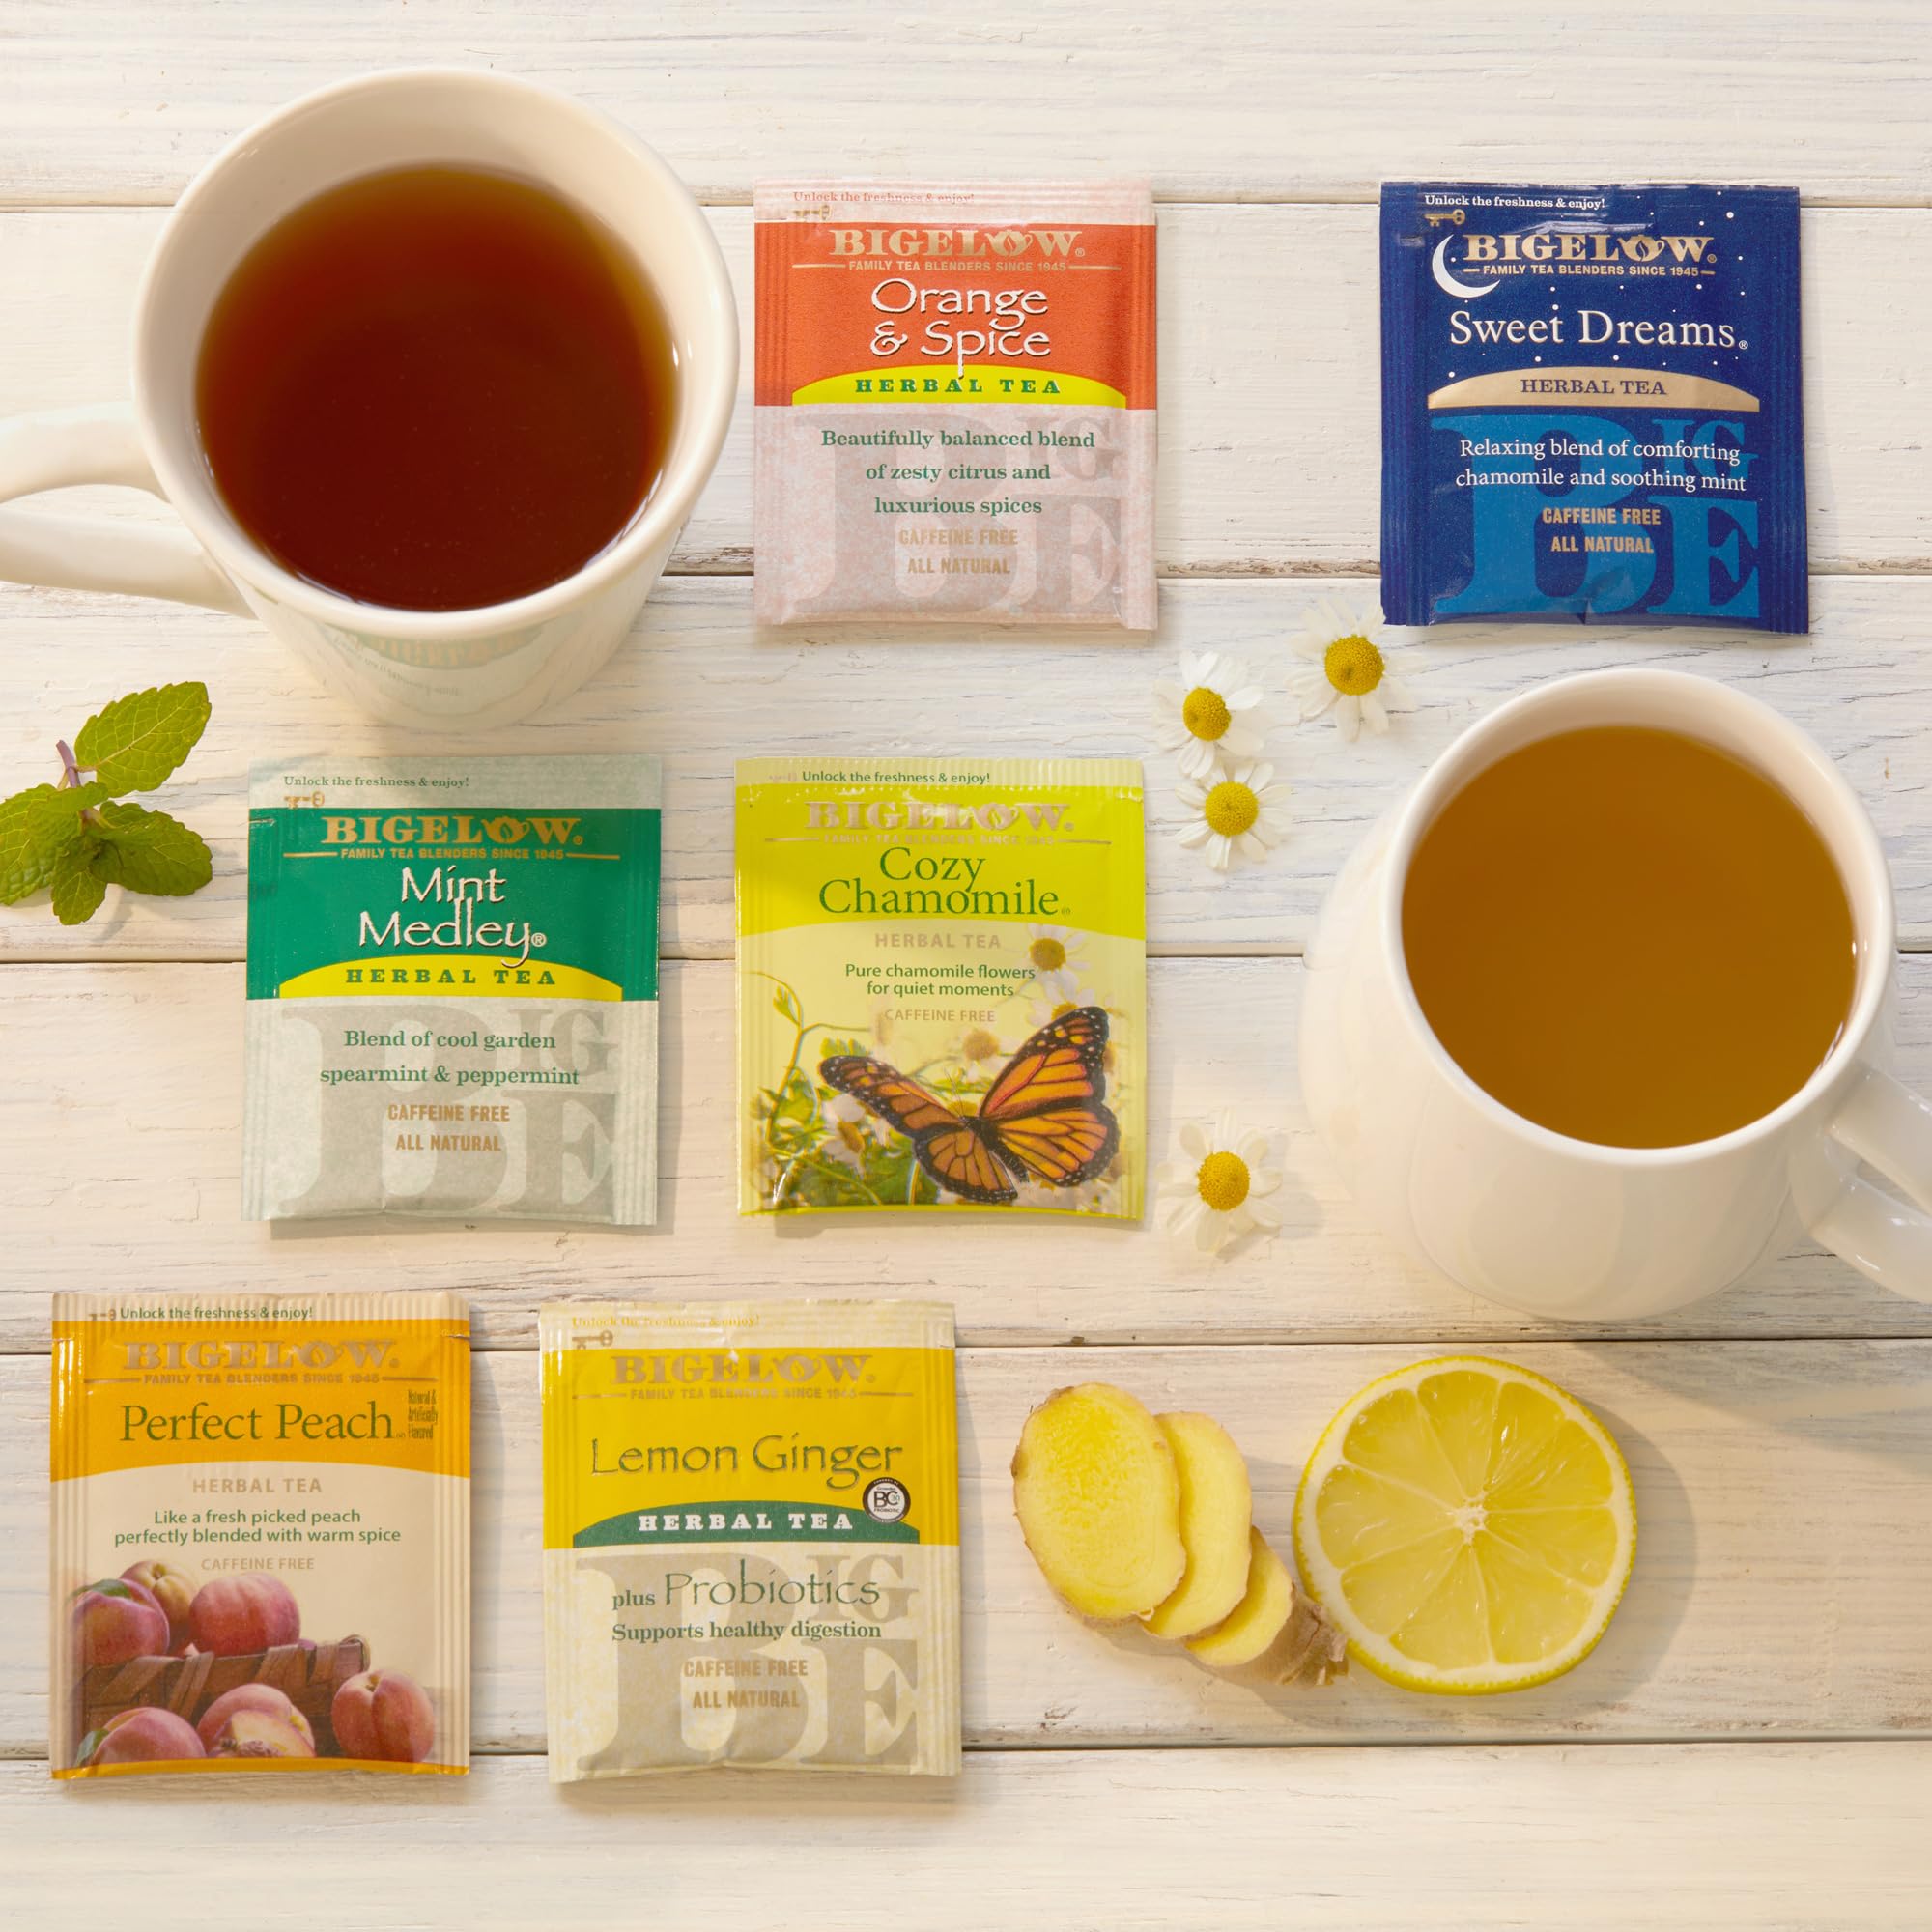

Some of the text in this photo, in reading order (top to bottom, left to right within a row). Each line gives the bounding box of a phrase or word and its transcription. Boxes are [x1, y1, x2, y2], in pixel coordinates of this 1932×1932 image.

[793, 192, 838, 202] Unlock
[840, 192, 859, 202] the
[1425, 195, 1605, 210] Unlock the freshness & enjoy!
[849, 260, 1066, 271] FAMILY TEA BLENDERS SINCE 1945
[1483, 265, 1699, 276] FAMILY TEA BLENDERS SINCE 1945
[871, 277, 1049, 331] Orange
[1450, 310, 1564, 345] Sweet
[870, 320, 1051, 380] & Spice
[856, 379, 1061, 394] HERBAL TEA
[1520, 378, 1667, 395] HERBAL TEA
[821, 429, 1094, 449] Beautifully balanced blend
[1460, 439, 1740, 464] Relaxing blend of comforting
[866, 464, 1051, 483] of zesty citrus and
[1455, 469, 1747, 493] chamomile and soothing mint
[874, 497, 1042, 518] luxurious spices
[1542, 507, 1661, 525] CAFFEINE FREE
[899, 529, 1018, 545] CAFFEINE FREE
[1550, 536, 1654, 554] ALL NATURAL
[907, 557, 1010, 574] ALL NATURAL
[284, 776, 469, 789] Unlock the freshness & enjoy!
[802, 771, 990, 785] Unlock the freshness & enjoy!
[876, 835, 900, 845] TEA
[980, 836, 1019, 845] SINCE
[341, 848, 564, 860] FAMILY TEA BLENDERS SINCE 1945
[879, 846, 986, 894] Cozy
[400, 865, 506, 904] Mint
[875, 932, 1001, 949] HERBAL TEA
[346, 968, 555, 985] HERBAL TEA
[845, 963, 1035, 980] Pure chamomile flowers
[867, 981, 1014, 998] for quiet moments
[884, 1009, 995, 1022] CAFFEINE FREE
[344, 1030, 556, 1052] Blend of cool garden
[320, 1065, 580, 1088] spearmint & peppermint
[387, 1104, 511, 1122] CAFFEINE FREE
[396, 1135, 501, 1151] ALL NATURAL
[120, 1306, 313, 1321] Unlock the freshness & enjoy!
[143, 1374, 191, 1384] FAMILY
[197, 1374, 221, 1384] TEA
[226, 1374, 298, 1384] BLENDERS
[303, 1374, 343, 1384] SINCE
[630, 1388, 675, 1400] FAMILY
[680, 1388, 704, 1399] TEA
[709, 1388, 779, 1399] BLENDERS
[783, 1388, 821, 1399] SINCE
[119, 1402, 262, 1442] Perfect
[591, 1432, 903, 1491] Lemon Ginger
[193, 1478, 323, 1492] HERBAL TEA
[154, 1509, 361, 1527] Like a fresh picked peach
[639, 1513, 772, 1531] HERBAL
[788, 1513, 853, 1530] TEA
[114, 1528, 401, 1548] perfectly blended with warm spice
[201, 1557, 315, 1570] CAFFEINE FREE
[611, 1558, 880, 1611] plus Probiotics
[611, 1620, 881, 1644] Supports healthy digestion
[684, 1660, 808, 1678] CAFFEINE FREE
[693, 1690, 800, 1709] ALL NATURAL
